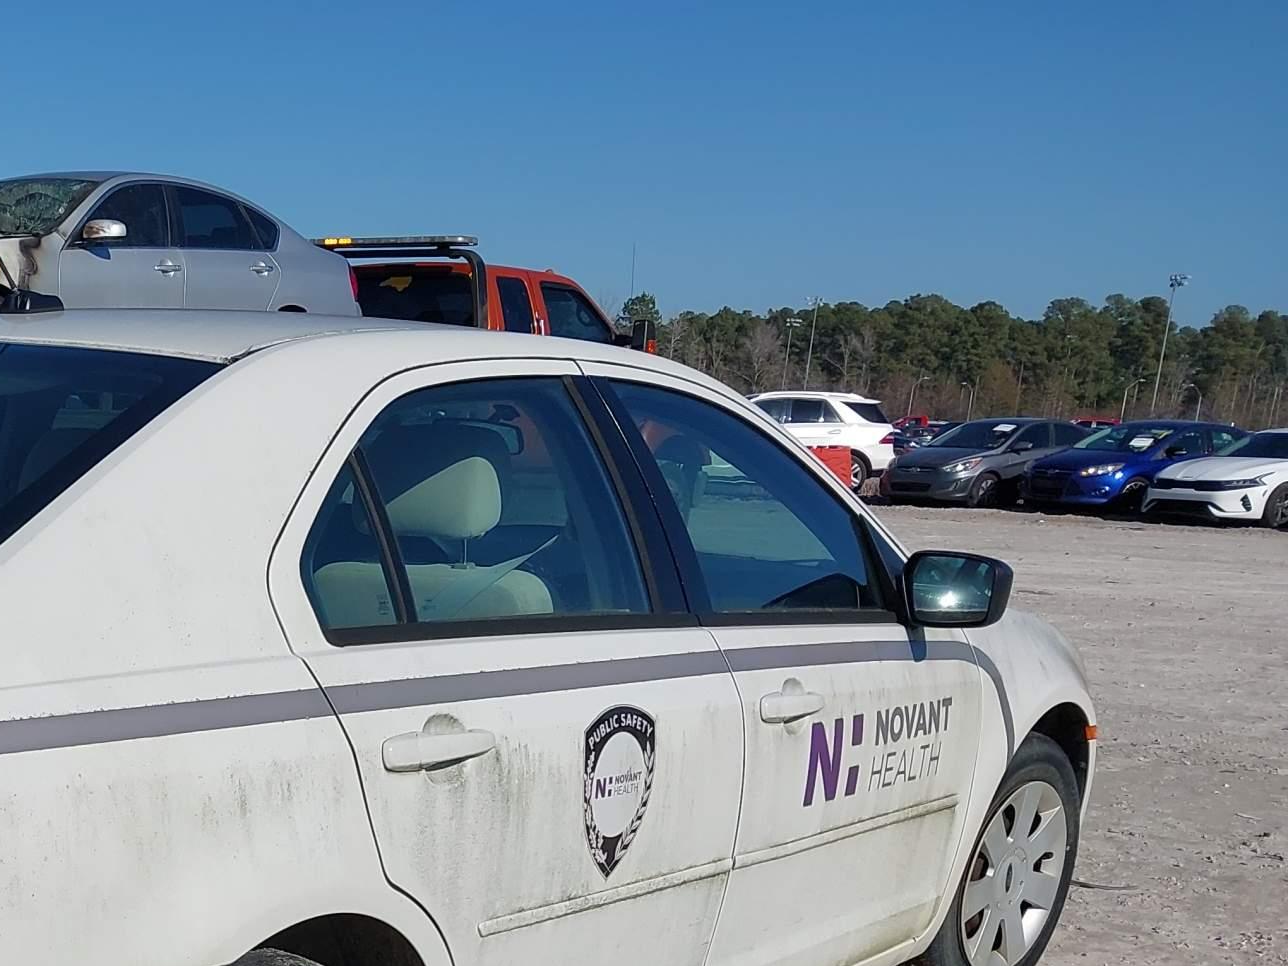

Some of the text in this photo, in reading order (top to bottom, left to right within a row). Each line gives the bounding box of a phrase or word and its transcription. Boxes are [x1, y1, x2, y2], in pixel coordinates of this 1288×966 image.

[588, 712, 654, 750] PUBLIC SAFETY
[874, 697, 953, 746] NOVANT
[614, 769, 643, 786] NOVANT
[868, 741, 942, 793] HEALTH
[613, 783, 640, 796] HEALTH
